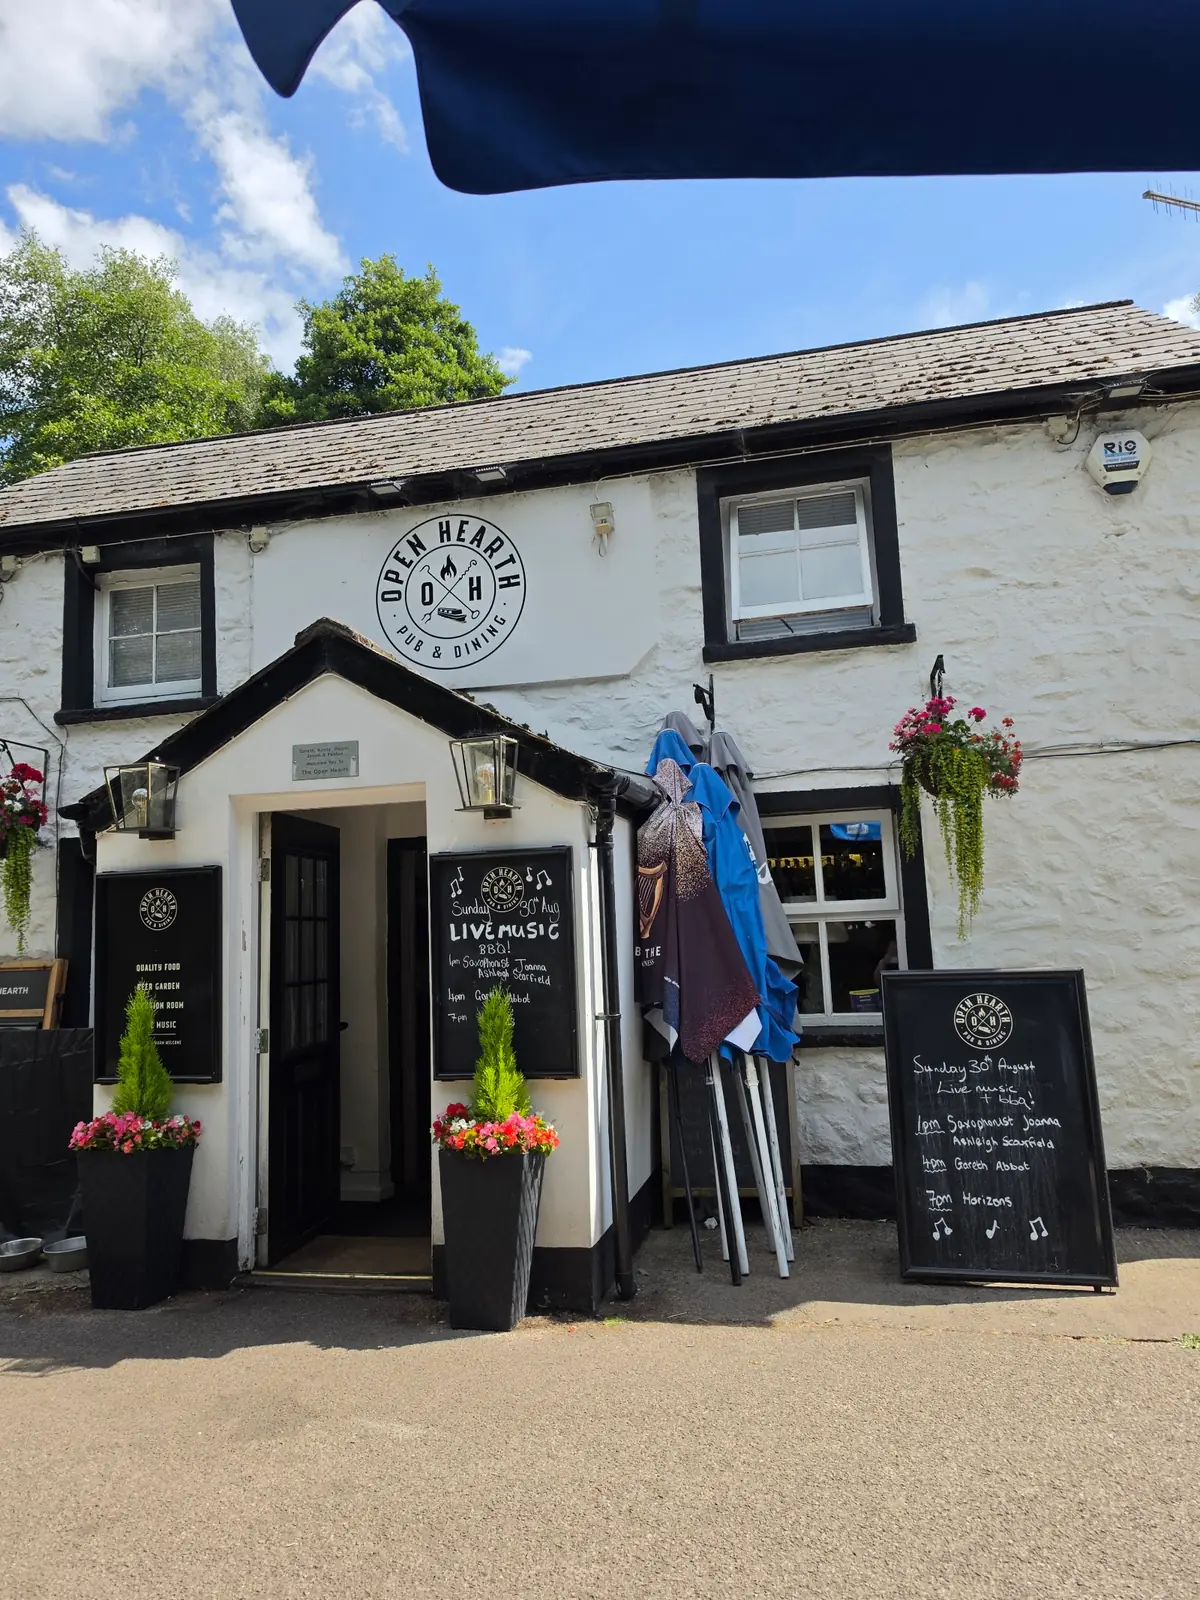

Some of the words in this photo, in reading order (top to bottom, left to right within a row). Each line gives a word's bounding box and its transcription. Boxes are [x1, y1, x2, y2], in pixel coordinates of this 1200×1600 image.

[381, 533, 427, 602] OPEN
[438, 520, 521, 589] HEARTH
[396, 625, 424, 652] PUB
[432, 646, 442, 658] &
[454, 615, 506, 658] DINING
[483, 871, 496, 892] OPEN
[499, 869, 523, 890] HEARTH
[141, 892, 153, 911] OPEN
[155, 890, 176, 910] HEARTH
[451, 897, 492, 923] Sunday
[541, 896, 561, 923] Aug
[450, 922, 495, 941] LIVE
[498, 921, 560, 940] MUSIC
[645, 946, 661, 959] THE
[136, 964, 162, 972] QUALITY
[164, 963, 180, 971] FOOD
[448, 954, 461, 967] 1pm
[514, 959, 547, 973] Joanna
[155, 982, 180, 991] GARDEN
[448, 988, 465, 1003] 4pm
[166, 1001, 184, 1009] ROOM
[956, 998, 973, 1023] OPEN
[976, 995, 1011, 1022] HEARTH
[156, 1021, 177, 1029] MUSIC
[447, 1013, 468, 1022] 7pm
[913, 1055, 967, 1083] Sunday
[997, 1057, 1036, 1074] August
[936, 1081, 972, 1094] Live
[975, 1083, 1018, 1094] music
[917, 1115, 941, 1132] 1pm
[1022, 1115, 1062, 1131] Joanna
[952, 1135, 999, 1153] Ashleigh
[922, 1154, 947, 1169] 4pm
[954, 1156, 989, 1171] Gareth
[995, 1157, 1031, 1172] Abbot
[926, 1190, 953, 1207] 7pm
[962, 1191, 1013, 1208] Horizons
